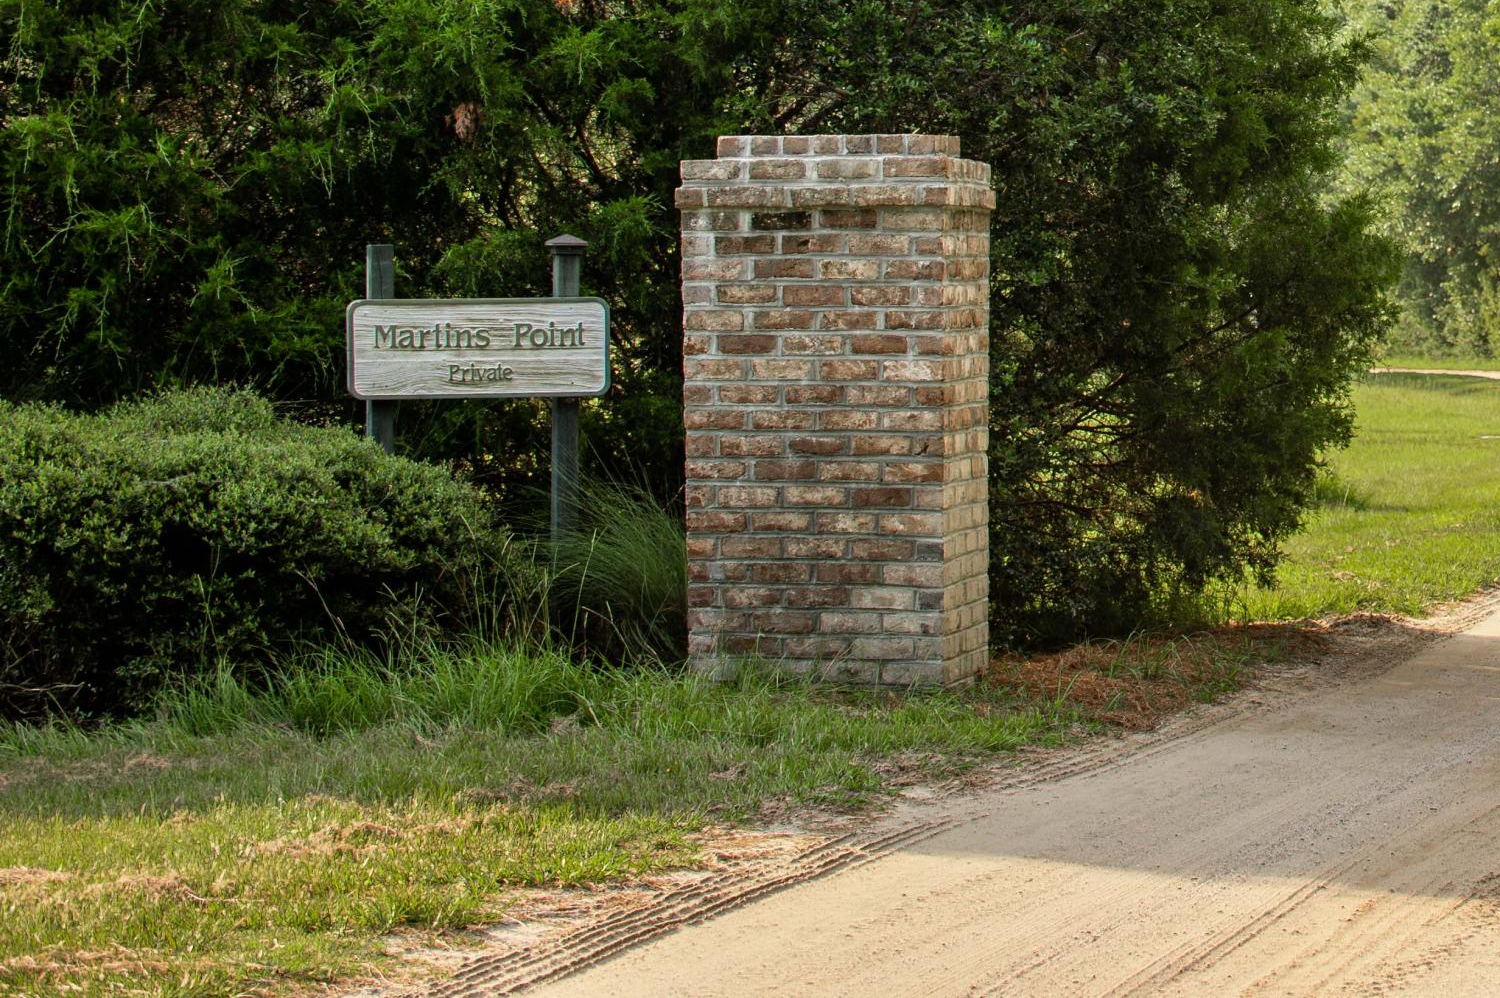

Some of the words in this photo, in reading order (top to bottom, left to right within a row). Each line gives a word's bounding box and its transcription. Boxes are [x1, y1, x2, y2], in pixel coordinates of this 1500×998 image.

[374, 322, 491, 349] Martins
[513, 321, 585, 347] Point
[448, 363, 514, 381] Private
